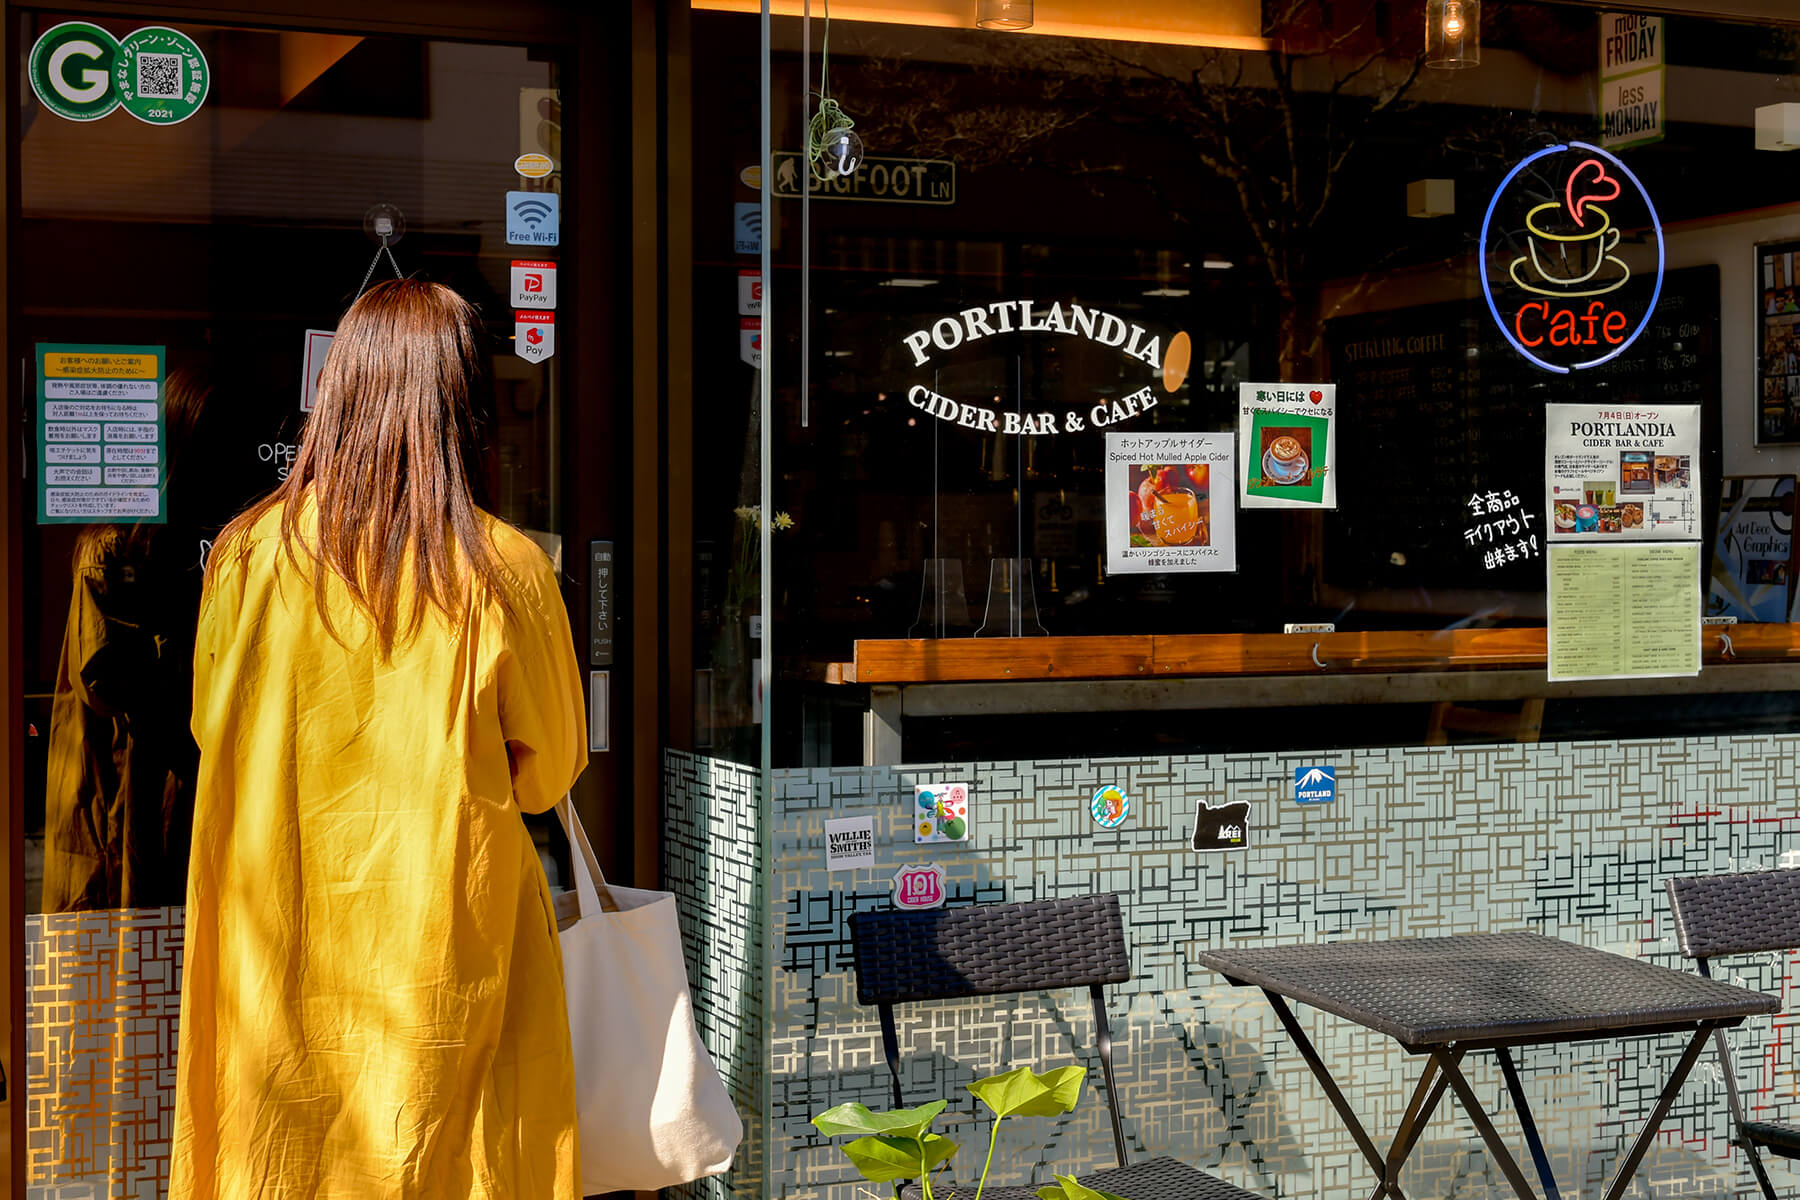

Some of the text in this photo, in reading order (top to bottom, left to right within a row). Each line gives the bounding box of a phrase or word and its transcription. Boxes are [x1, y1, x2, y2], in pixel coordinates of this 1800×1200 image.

[1606, 26, 1656, 68] FRIDAY
[48, 40, 109, 104] G
[1618, 86, 1645, 108] less
[148, 109, 173, 118] 2021
[1605, 101, 1658, 139] MONDAY
[930, 181, 950, 198] LN
[509, 231, 557, 242] Free Wi-Fi
[519, 293, 548, 303] PayPay
[903, 300, 1161, 369] PORTLANDIA
[525, 345, 543, 356] Pay
[1256, 390, 1305, 403] 寒い日には
[907, 384, 1159, 435] CIDER BAR & CAFE
[1242, 407, 1334, 417] 甘くてスパイシーでクセになる
[1571, 422, 1677, 437] PORTLANDIA
[1120, 438, 1213, 449] ホットアップルサイダー
[1583, 439, 1665, 448] CIDER BAR & CAFE
[258, 442, 304, 464] OPE
[1110, 452, 1230, 462] Spiced Hot Mulled Apple Cider
[1467, 489, 1520, 517] 全商品
[1152, 515, 1175, 531] 甘くて
[1164, 519, 1204, 538] スパイシー
[1463, 508, 1536, 546] テイクアウト
[1735, 521, 1771, 534] Art Deco
[1743, 535, 1789, 557] Graphics
[598, 567, 609, 631] 押して下さい
[1298, 790, 1332, 799] PORTLAND
[829, 829, 871, 844] WILLIE
[905, 873, 935, 897] 101
